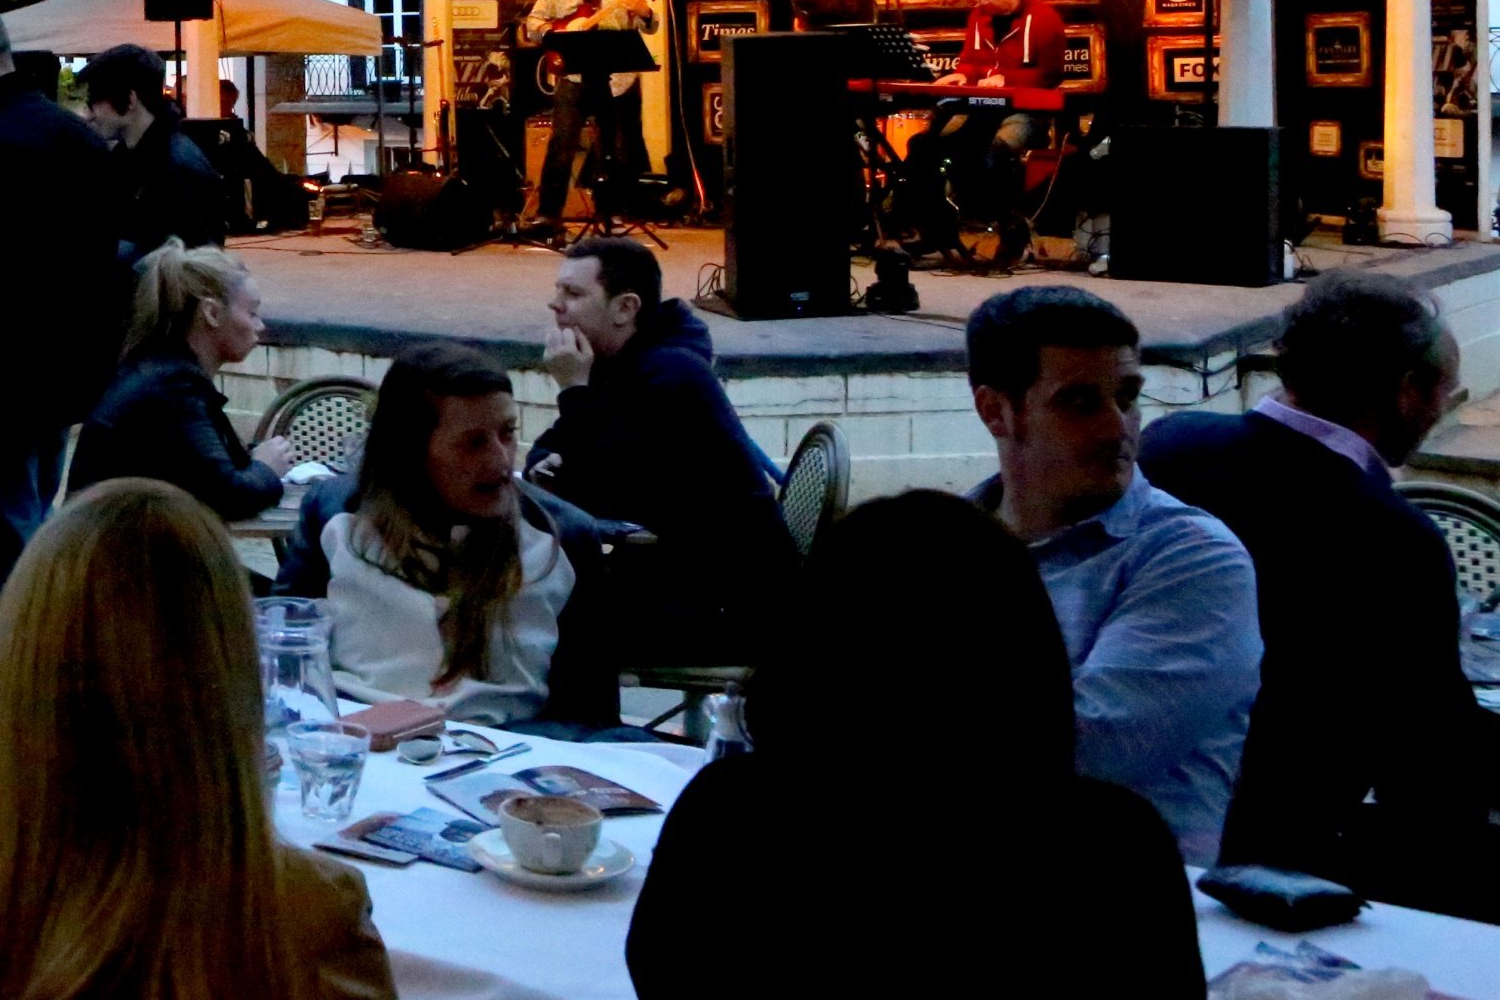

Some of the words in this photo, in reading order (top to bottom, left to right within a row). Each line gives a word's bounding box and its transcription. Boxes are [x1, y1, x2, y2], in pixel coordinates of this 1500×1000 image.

[701, 23, 756, 41] Times
[1064, 64, 1089, 72] mes
[968, 97, 1006, 106] STAGE
